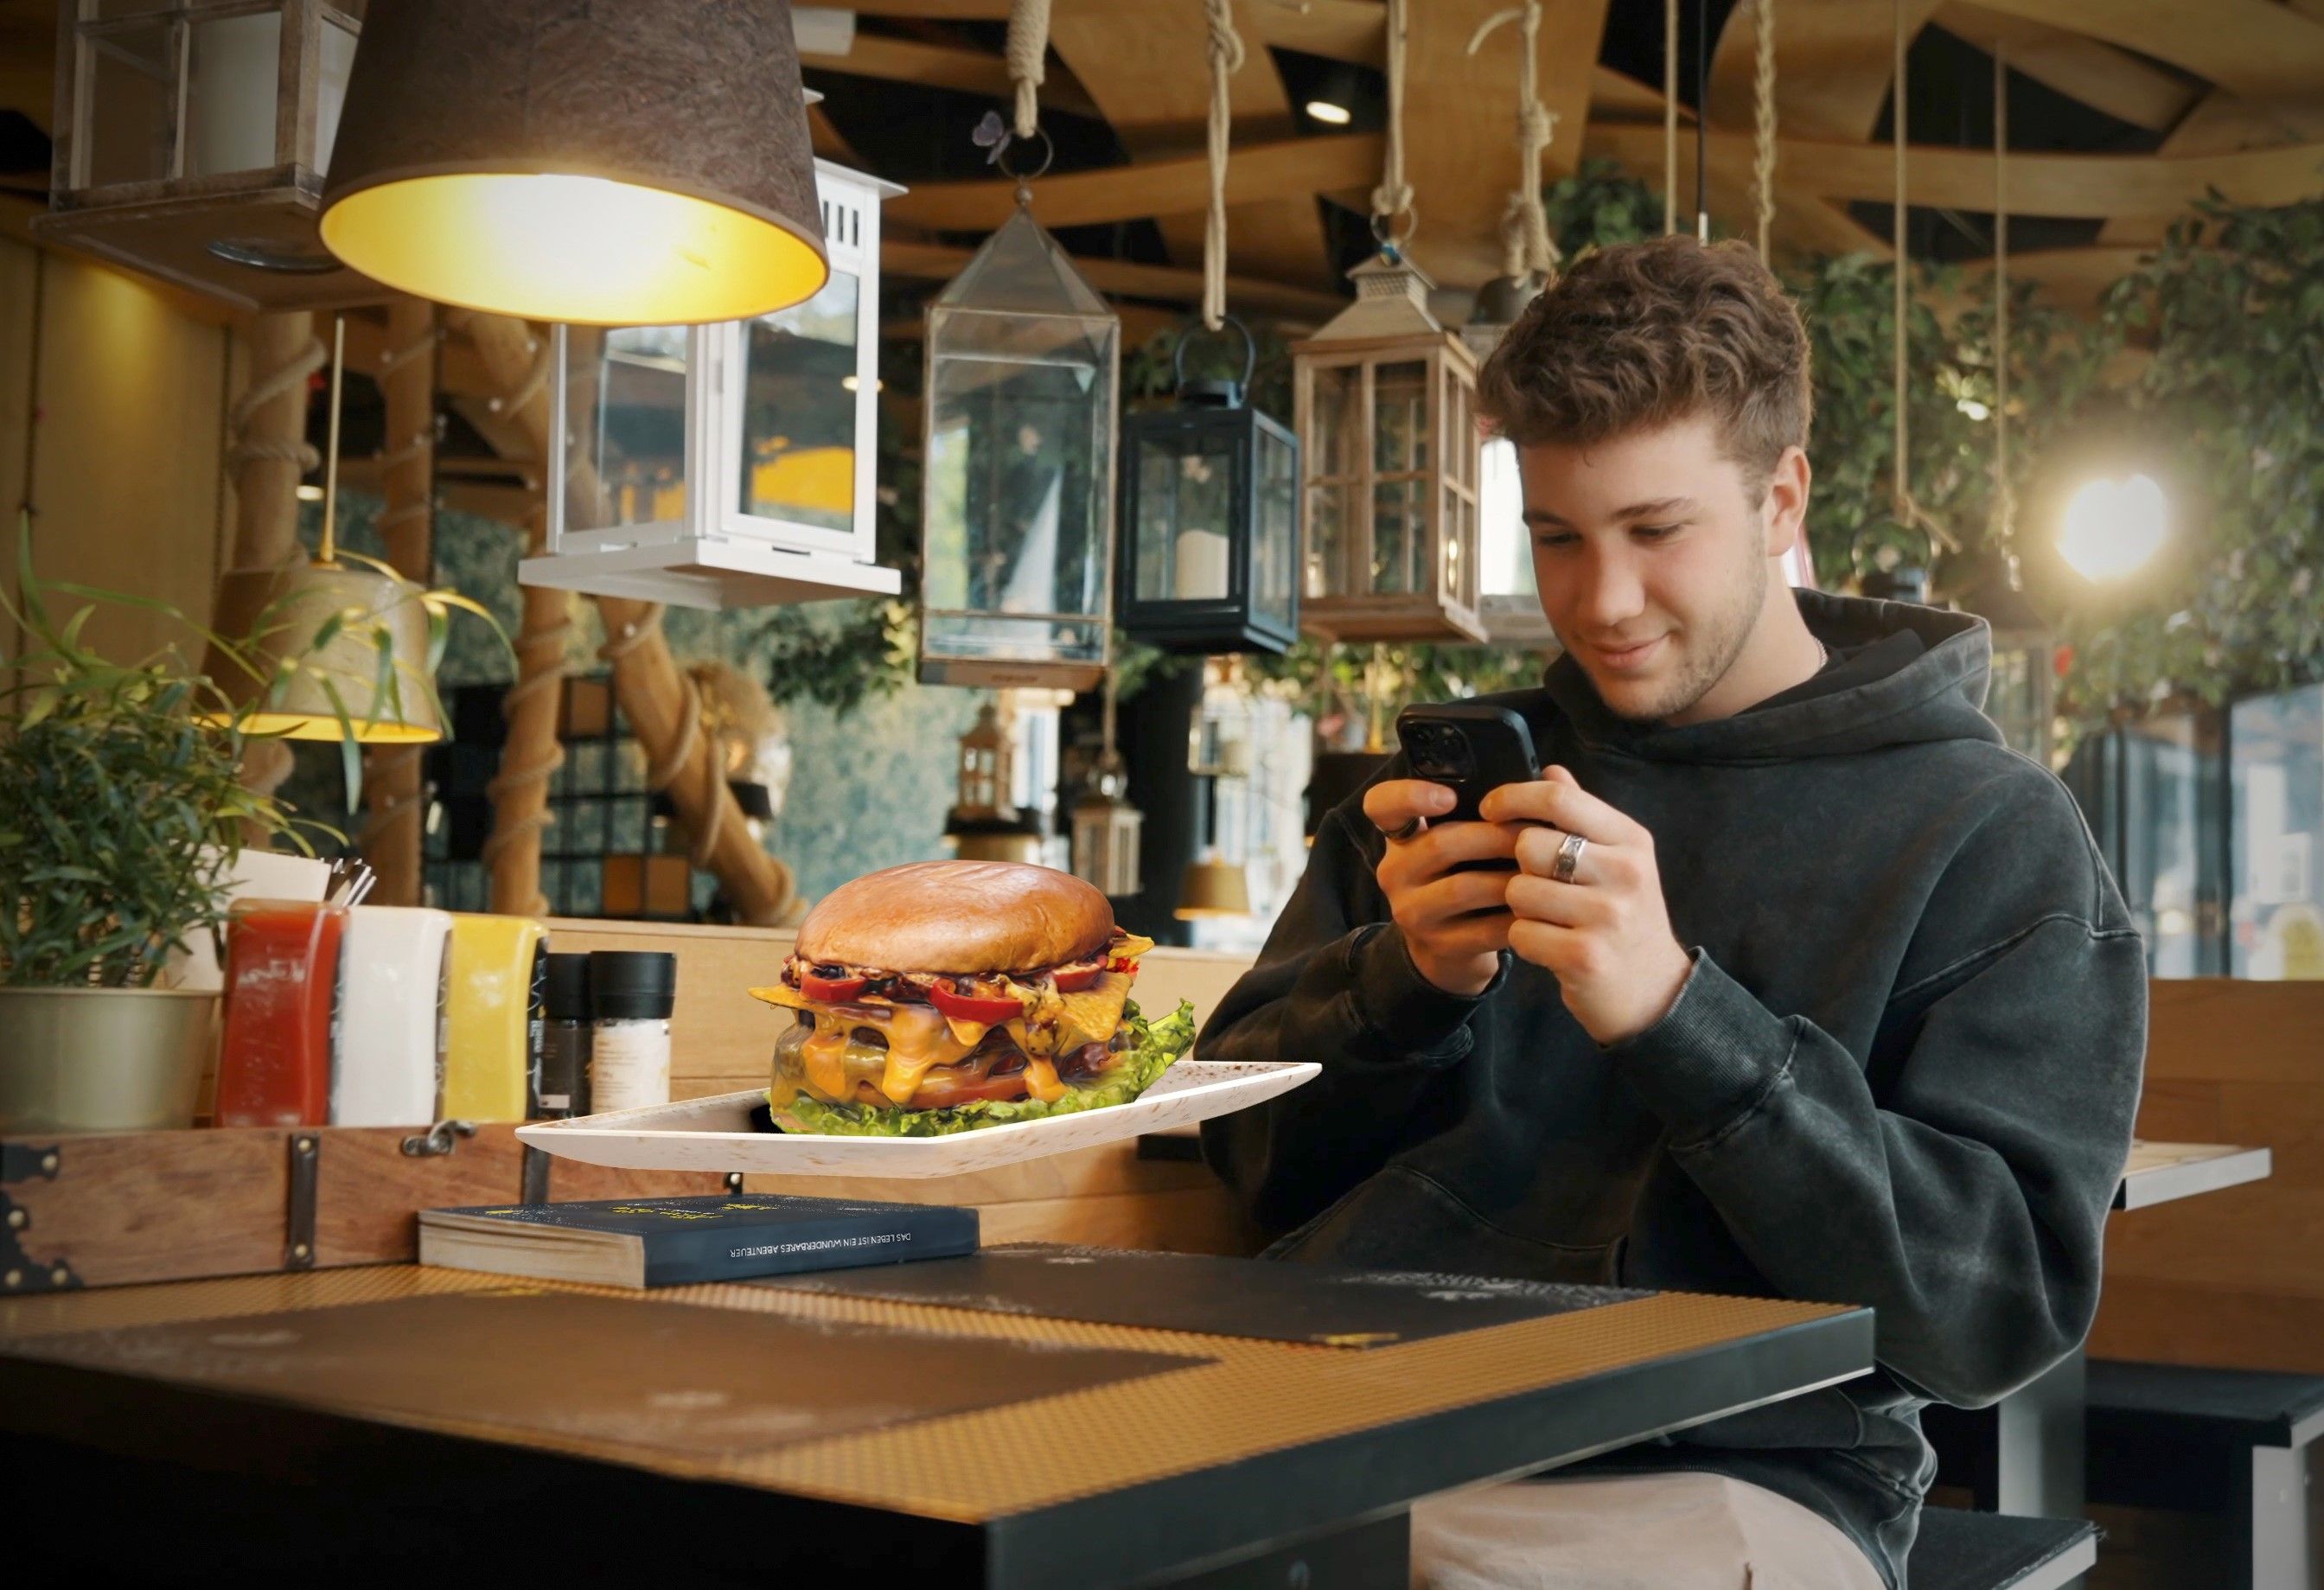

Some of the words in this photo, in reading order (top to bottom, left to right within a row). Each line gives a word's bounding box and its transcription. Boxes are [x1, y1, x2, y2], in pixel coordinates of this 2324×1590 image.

[843, 1237, 857, 1247] EIN
[858, 1236, 870, 1246] IST
[871, 1234, 895, 1244] LEBEN
[897, 1232, 911, 1242] DAS
[730, 1245, 779, 1258] ABENTEUER
[780, 1239, 842, 1254] WUNDERBARES
